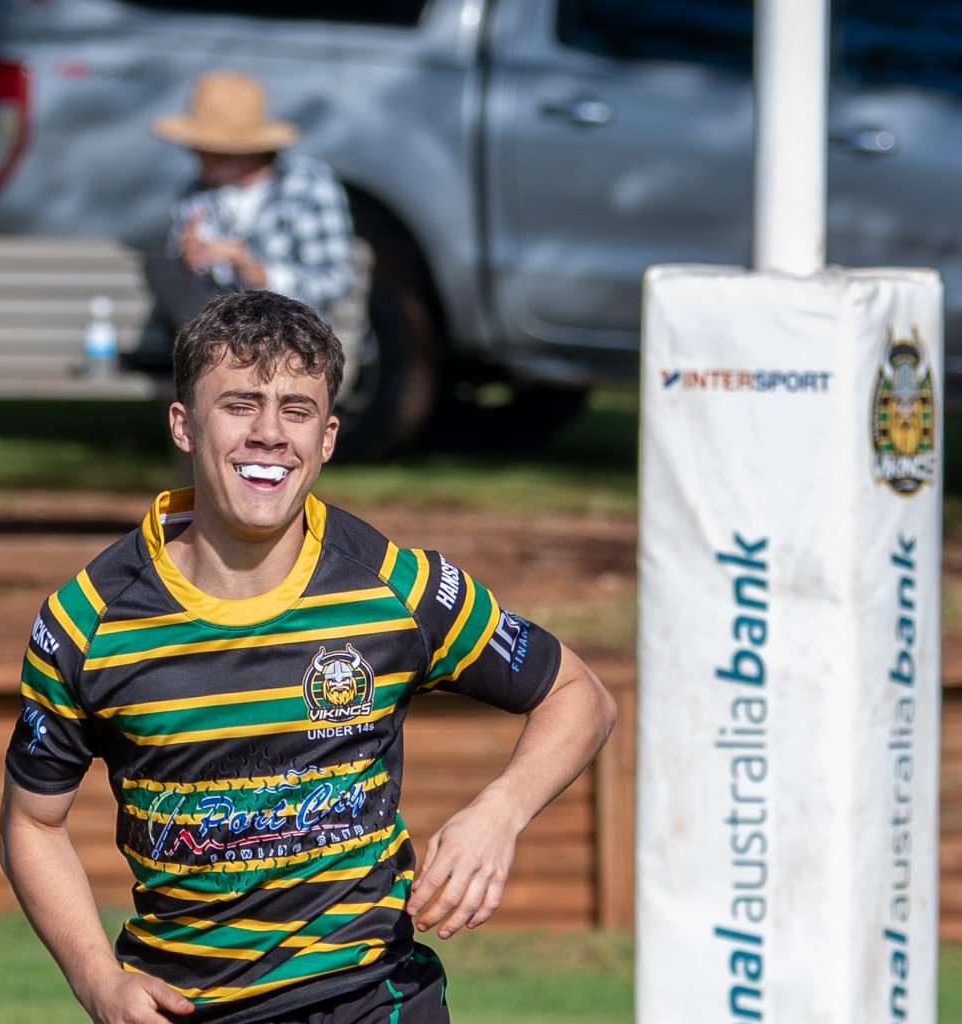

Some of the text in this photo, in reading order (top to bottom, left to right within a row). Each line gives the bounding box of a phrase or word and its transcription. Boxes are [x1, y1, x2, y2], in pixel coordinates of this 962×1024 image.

[681, 369, 832, 393] INTERSPORT
[309, 702, 372, 721] VIKINGS
[307, 722, 375, 740] UNDER 14s
[196, 782, 367, 838] Port City
